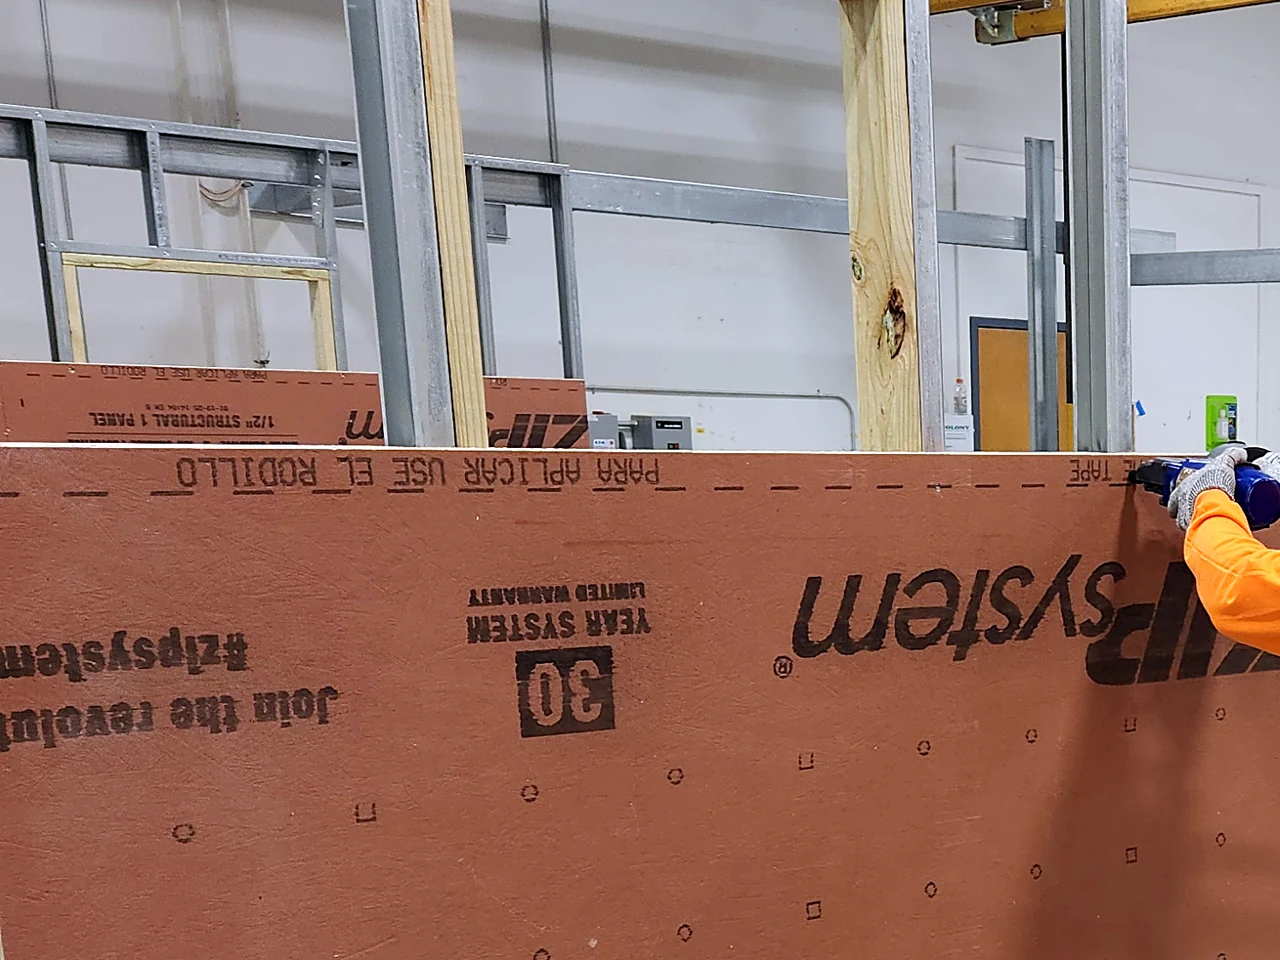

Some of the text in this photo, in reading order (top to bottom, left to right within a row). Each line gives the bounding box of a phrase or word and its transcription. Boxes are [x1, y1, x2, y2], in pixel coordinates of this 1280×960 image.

[88, 412, 275, 429] 1/2" STRUCTURAL 1 PANEL
[176, 456, 660, 488] PARA APLICAR USE EL RODILLO
[1070, 459, 1112, 481] TAPE
[467, 581, 648, 608] LIMITED WARRANTY
[467, 607, 651, 643] YEAR SYSTEM
[168, 693, 242, 735] the
[252, 685, 345, 729] Join
